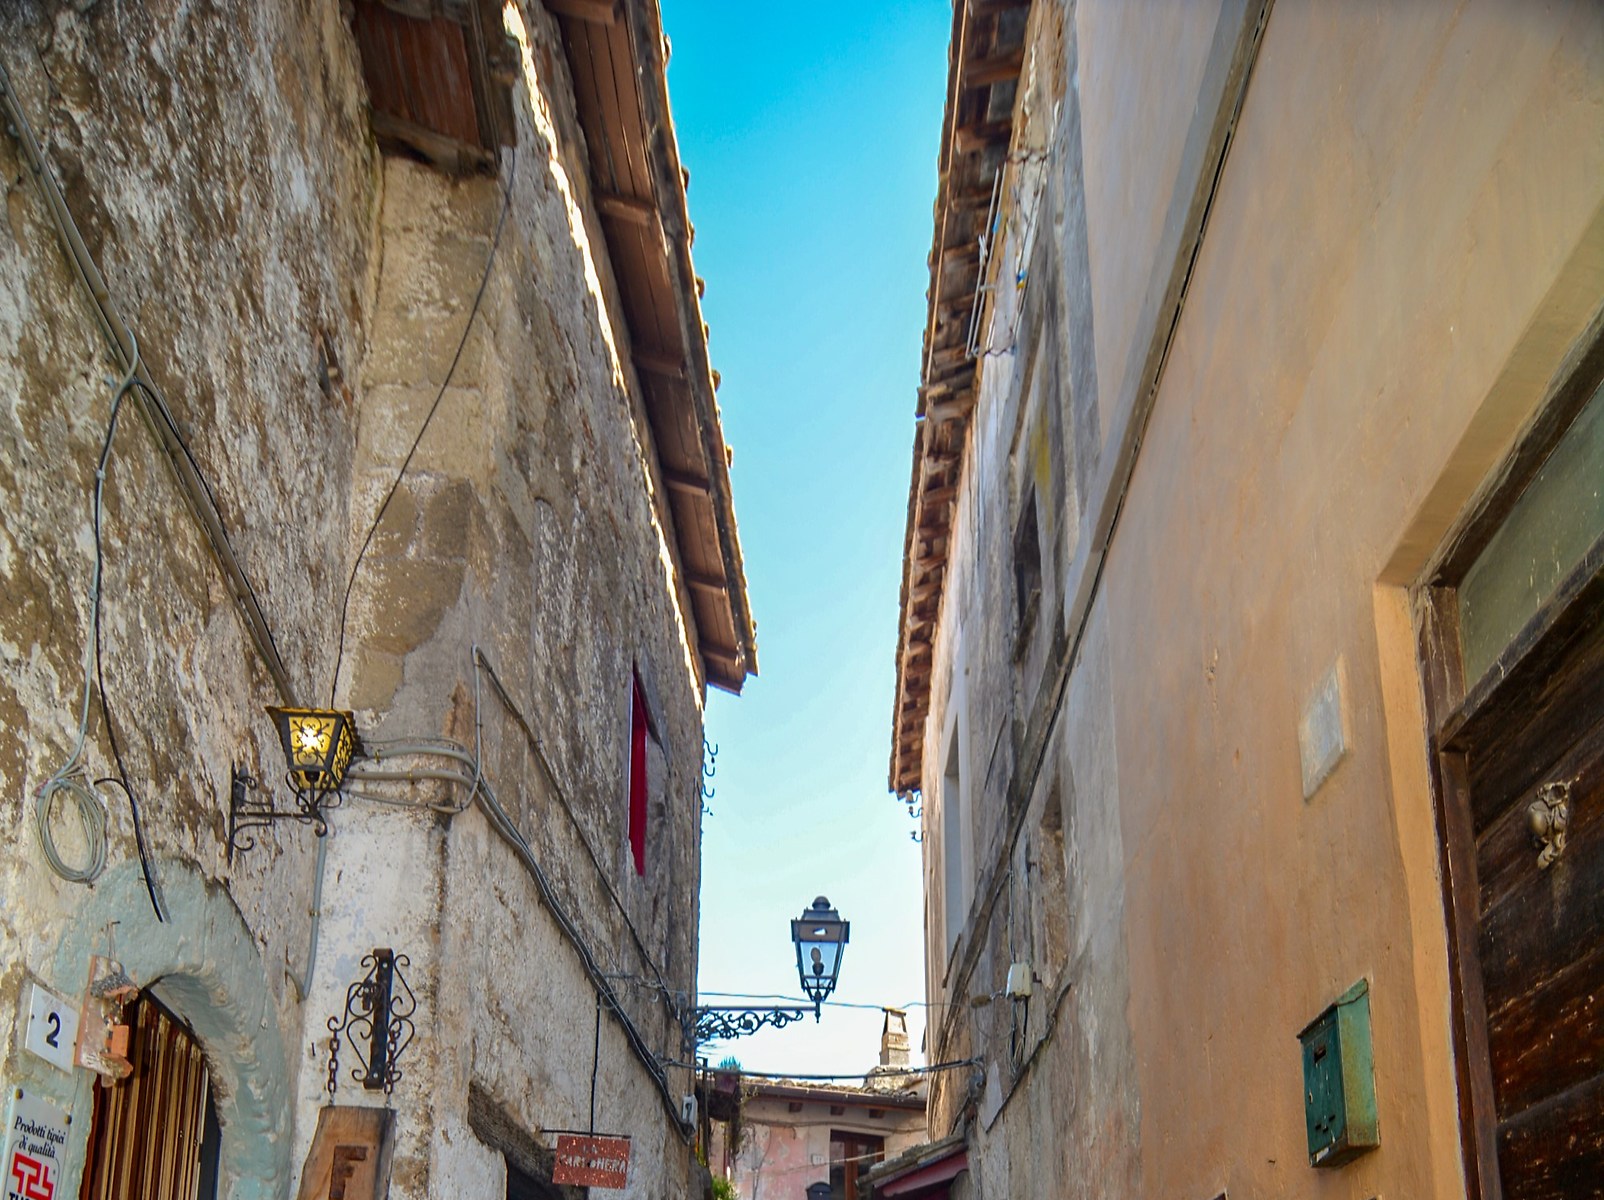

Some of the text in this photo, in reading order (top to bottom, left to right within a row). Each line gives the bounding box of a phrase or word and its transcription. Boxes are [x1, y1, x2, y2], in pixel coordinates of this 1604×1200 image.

[46, 1011, 61, 1049] 2
[14, 1115, 66, 1145] Prodotti tipici
[18, 1134, 56, 1159] di qualità
